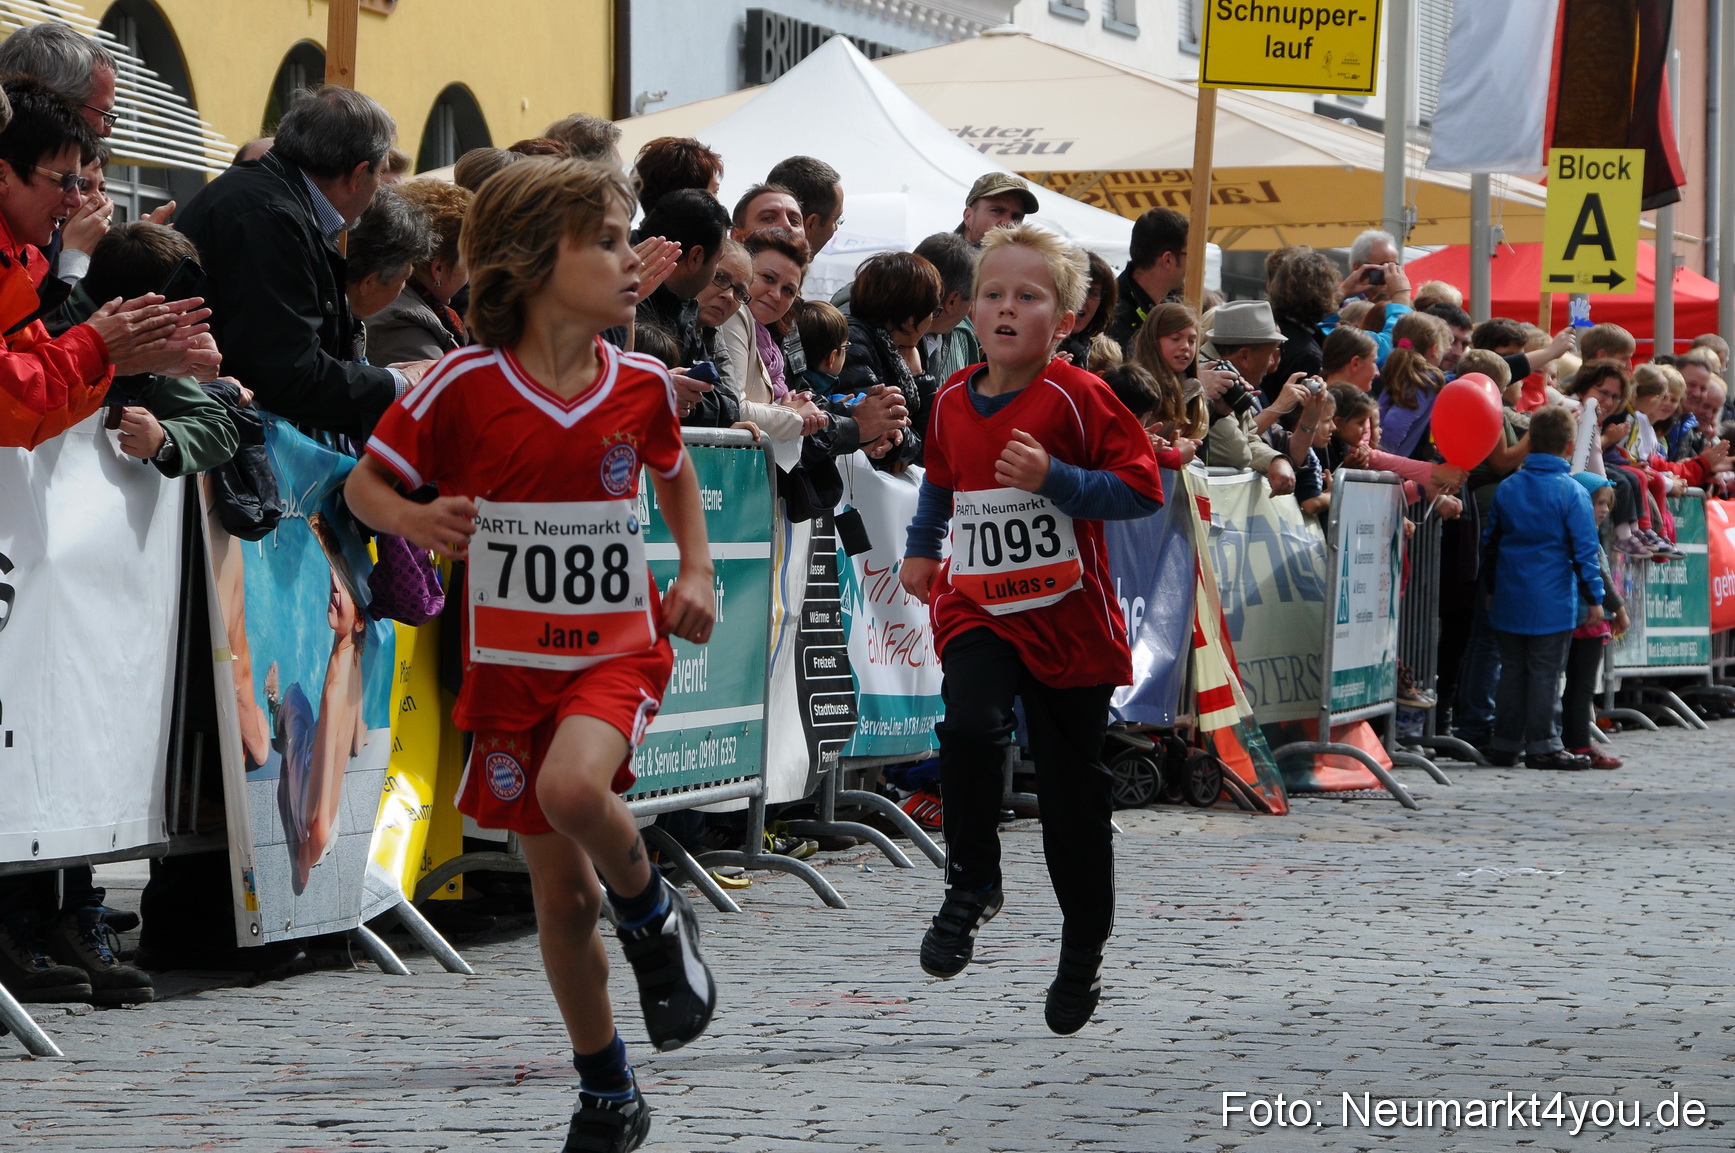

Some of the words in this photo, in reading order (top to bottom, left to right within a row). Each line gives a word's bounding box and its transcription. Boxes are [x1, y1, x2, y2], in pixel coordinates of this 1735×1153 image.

[1216, 0, 1367, 31] Schnupper-
[1265, 34, 1314, 60] lauf
[1558, 154, 1632, 180] Block
[1562, 192, 1617, 262] A
[700, 484, 723, 512] steme
[956, 503, 980, 516] PARTL
[982, 498, 1046, 516] Neumarkt
[474, 515, 529, 535] PARTL
[534, 519, 621, 536] Neumarkt
[961, 513, 1062, 568] 7093
[1066, 548, 1076, 558] M
[487, 541, 630, 605] 7088
[810, 564, 826, 576] asser
[955, 563, 961, 572] 4
[478, 591, 485, 603] 4
[983, 577, 1042, 600] Lukas
[634, 597, 643, 607] M
[809, 610, 830, 624] Wärme
[537, 621, 583, 649] Jan
[670, 646, 709, 695] Event!
[813, 656, 837, 669] Freizeit
[813, 702, 850, 717] Stadtbusse
[646, 747, 654, 777] &
[655, 743, 679, 777] Service
[680, 741, 699, 772] Line:
[699, 738, 720, 769] 09181
[720, 735, 737, 766] 6352
